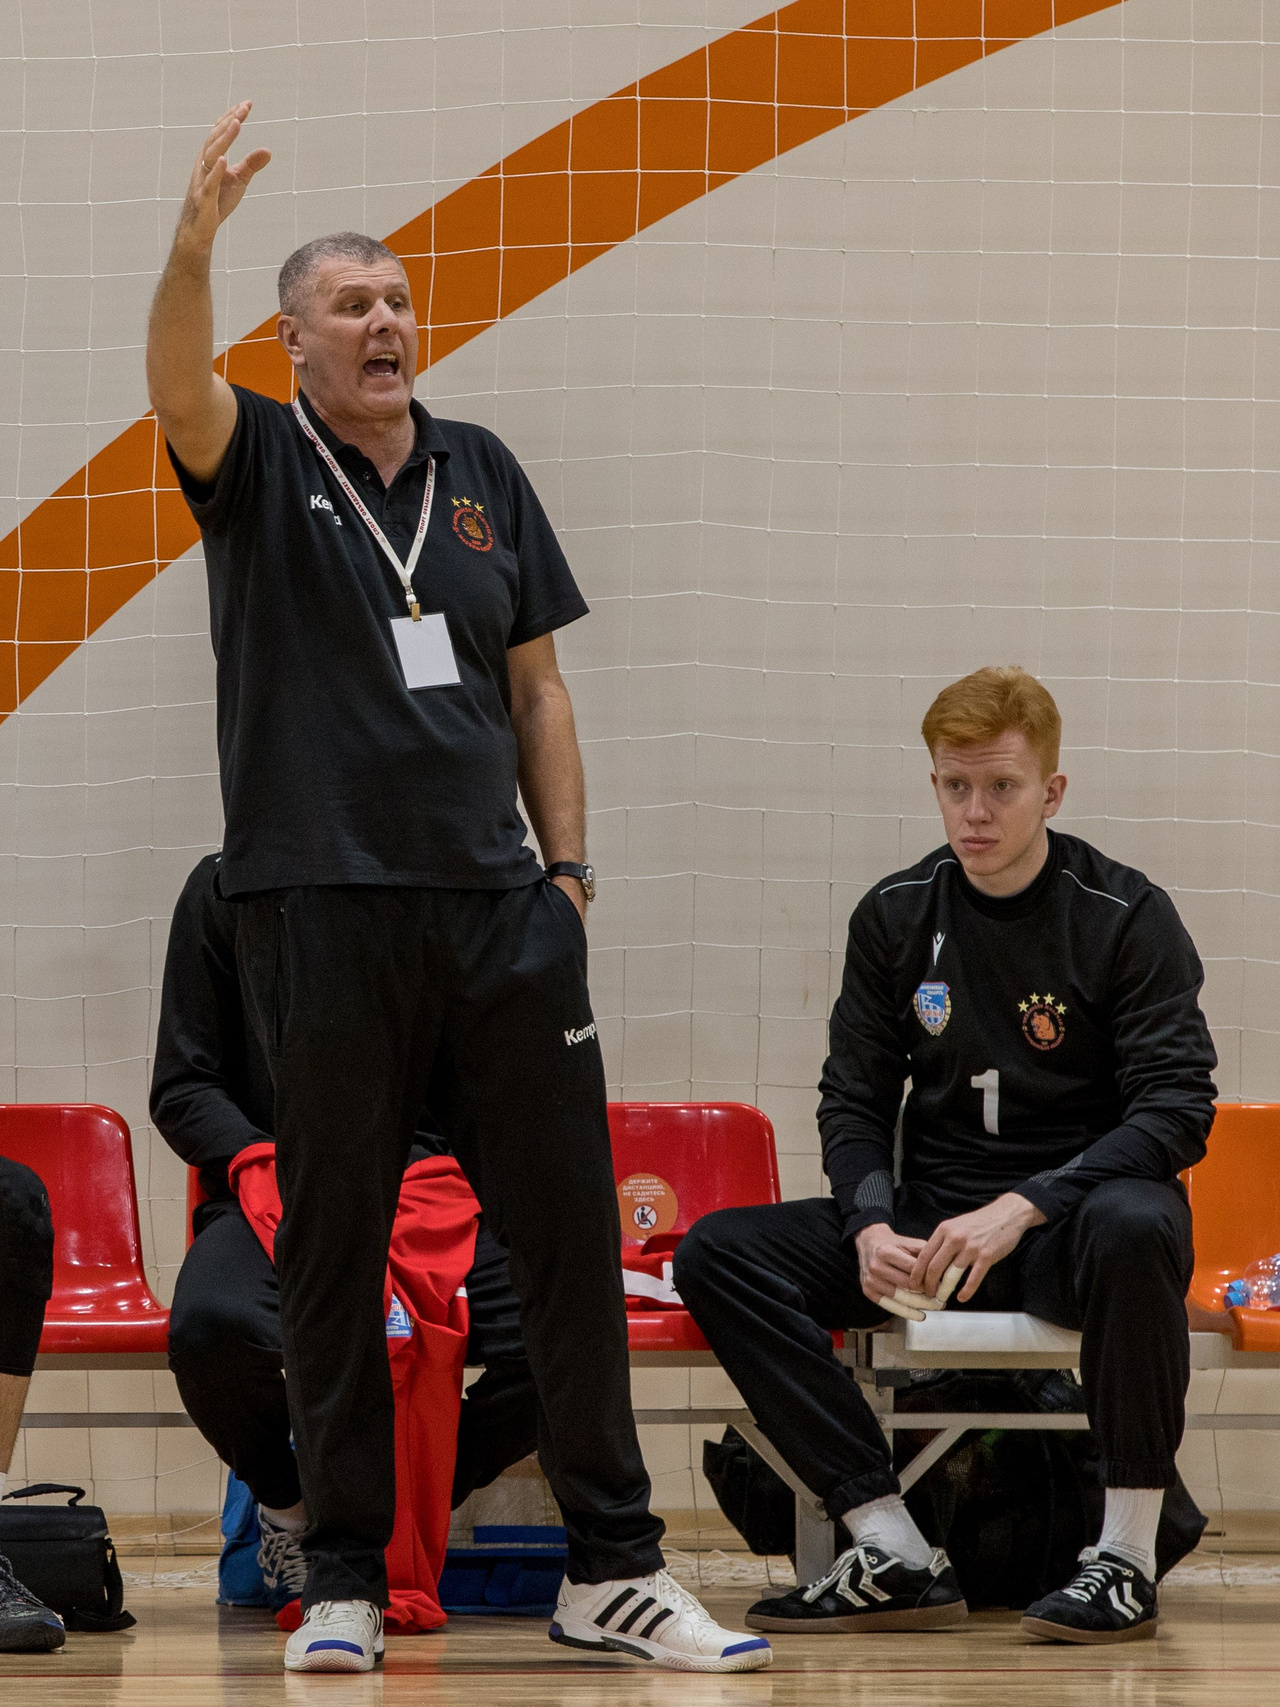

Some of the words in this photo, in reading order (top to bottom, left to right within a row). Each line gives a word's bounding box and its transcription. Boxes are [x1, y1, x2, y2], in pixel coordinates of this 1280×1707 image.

[310, 494, 342, 526] Kea
[366, 517, 380, 535] СПОРТ
[970, 1068, 1000, 1136] 1
